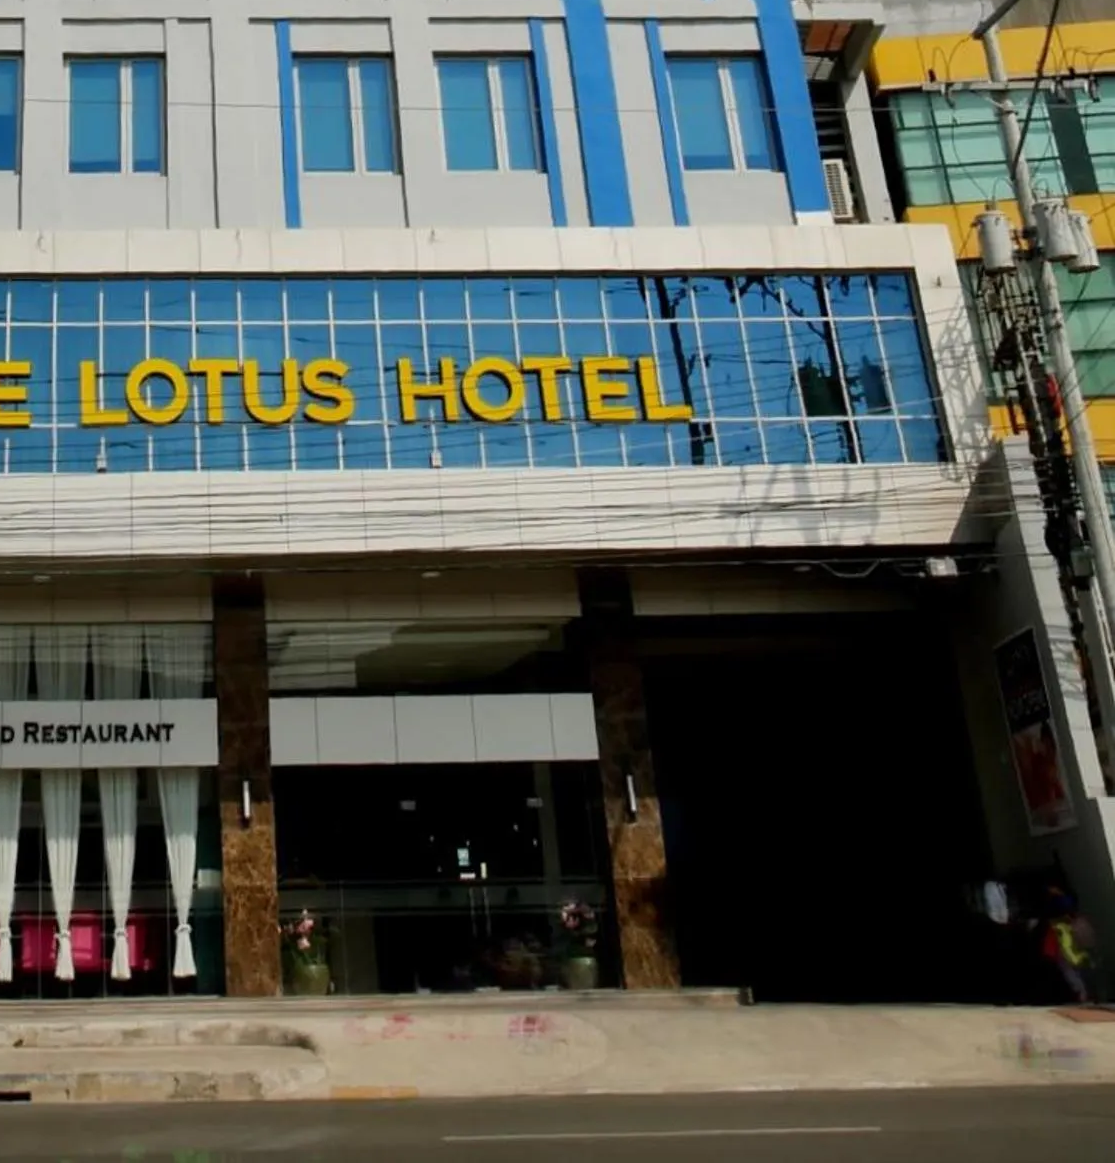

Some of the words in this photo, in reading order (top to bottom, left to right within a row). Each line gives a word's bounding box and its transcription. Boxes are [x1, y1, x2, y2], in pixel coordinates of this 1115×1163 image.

[79, 358, 355, 428] LOTUS
[397, 355, 693, 426] HOTEL
[23, 722, 174, 745] RESTAURANT
